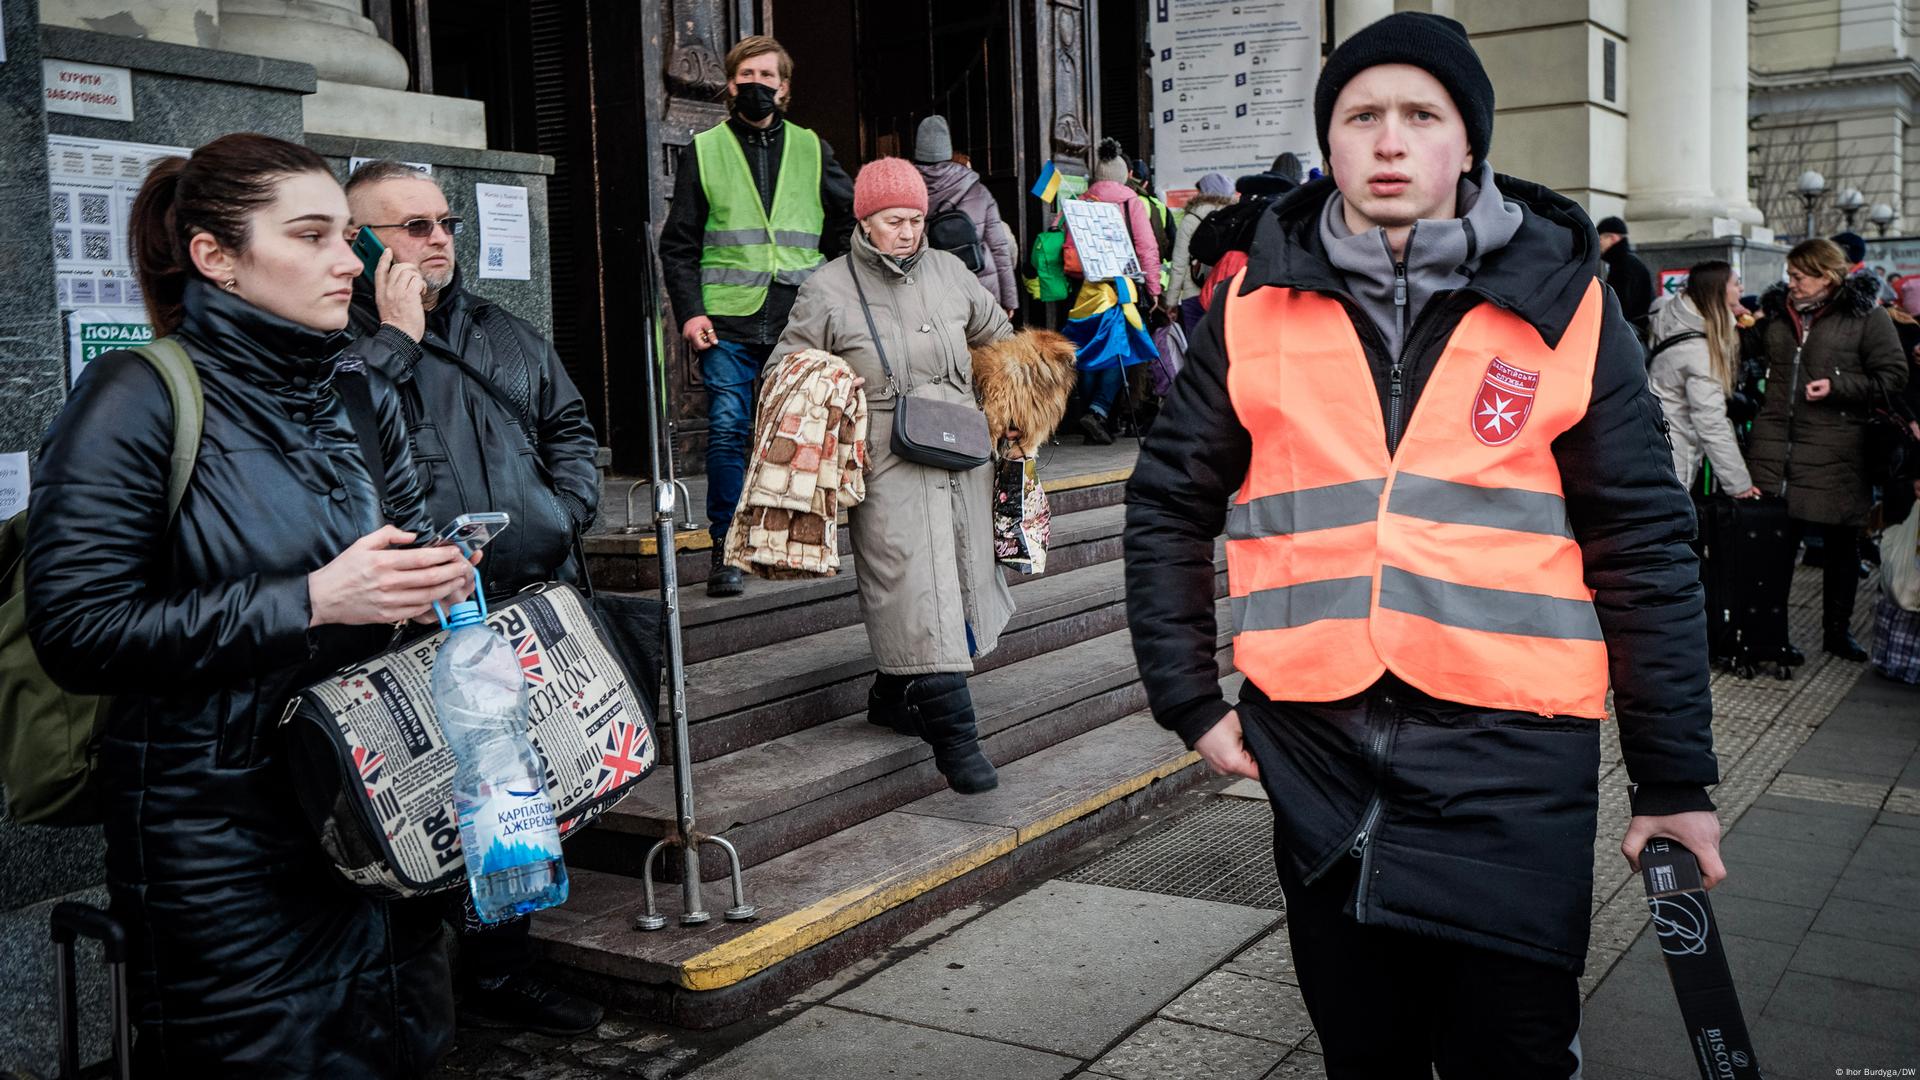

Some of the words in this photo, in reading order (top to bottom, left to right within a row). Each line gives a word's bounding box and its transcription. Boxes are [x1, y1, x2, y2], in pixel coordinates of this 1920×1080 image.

[45, 87, 118, 106] ЗАБОРОНЕНО
[59, 71, 102, 86] КУРИТИ
[380, 671, 420, 733] SUBSCRIBING
[415, 729, 427, 746] IS
[382, 690, 397, 713] MORE
[393, 711, 415, 749] RELIABLE
[422, 804, 464, 868] FOR
